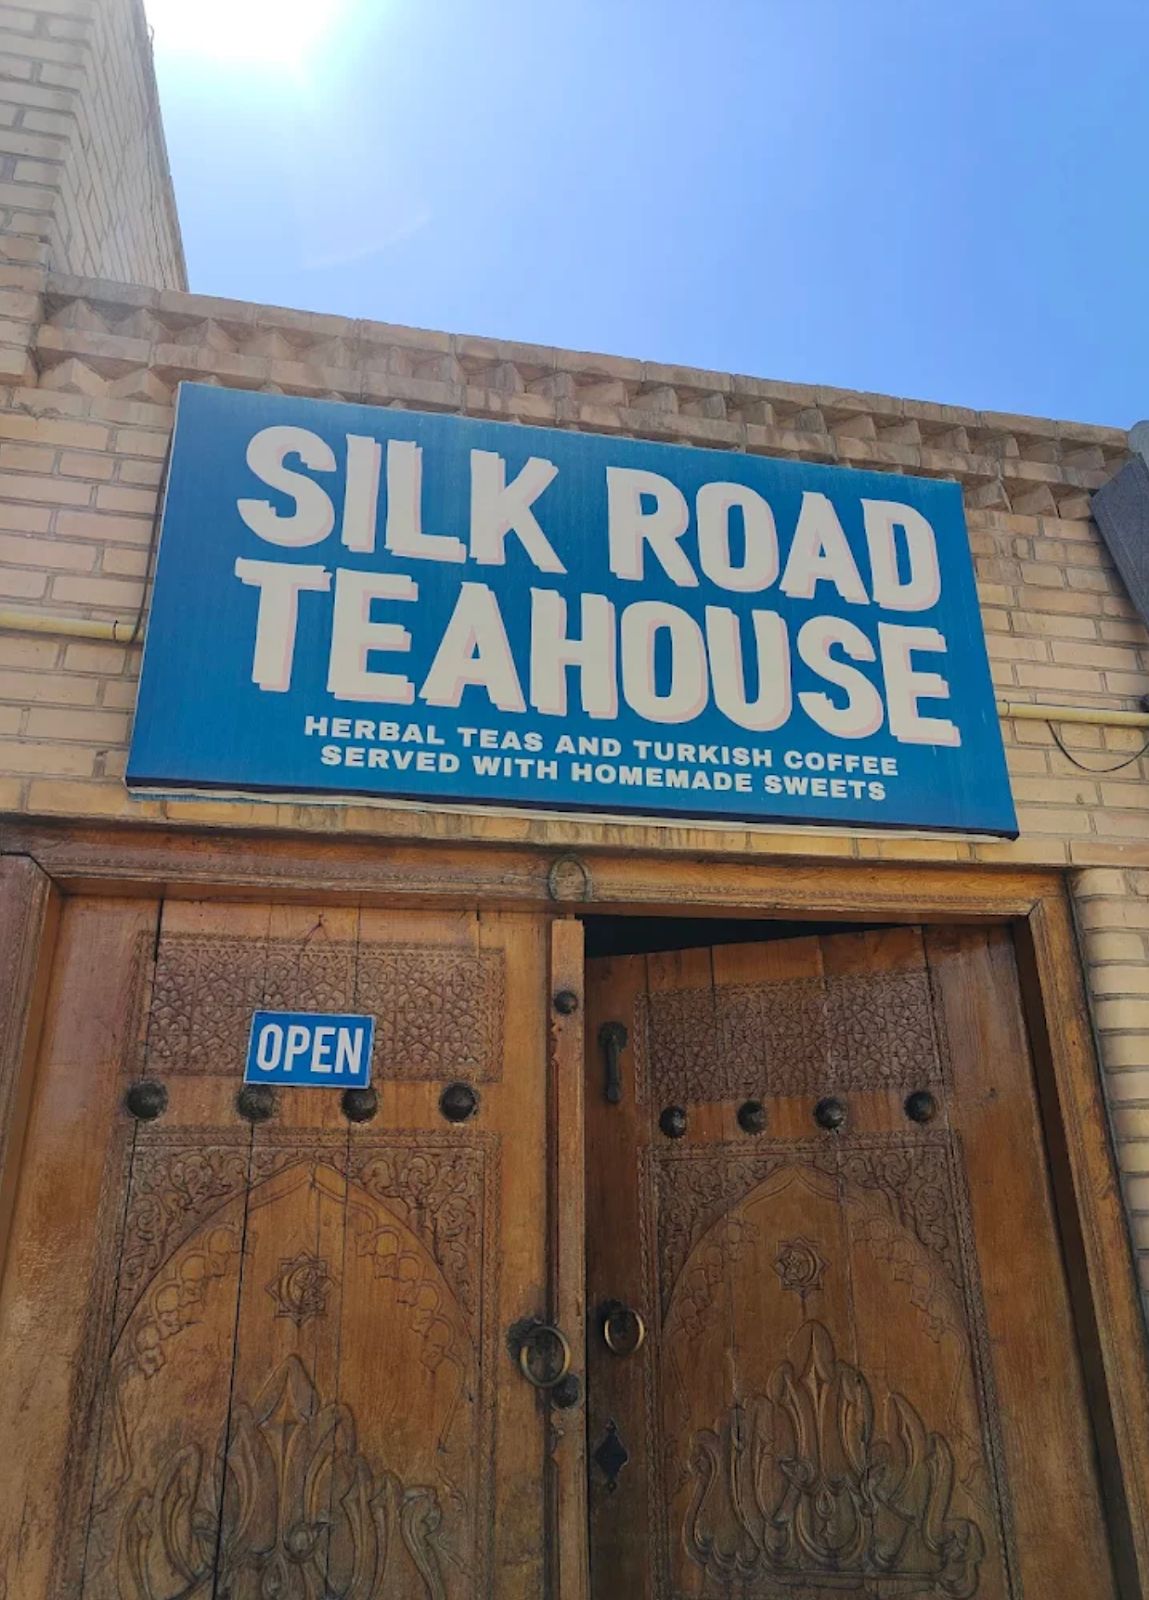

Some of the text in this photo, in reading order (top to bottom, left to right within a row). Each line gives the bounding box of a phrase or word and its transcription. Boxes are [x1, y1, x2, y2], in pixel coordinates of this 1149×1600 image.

[237, 426, 941, 611] SILK ROAD
[235, 558, 961, 747] TEAHOUSE
[305, 716, 897, 775] HERBAL TEAS AND TURKISH COFFEE
[320, 746, 885, 800] SERVED WITH HOMEMADE SWEETS
[257, 1024, 364, 1074] OPEN
